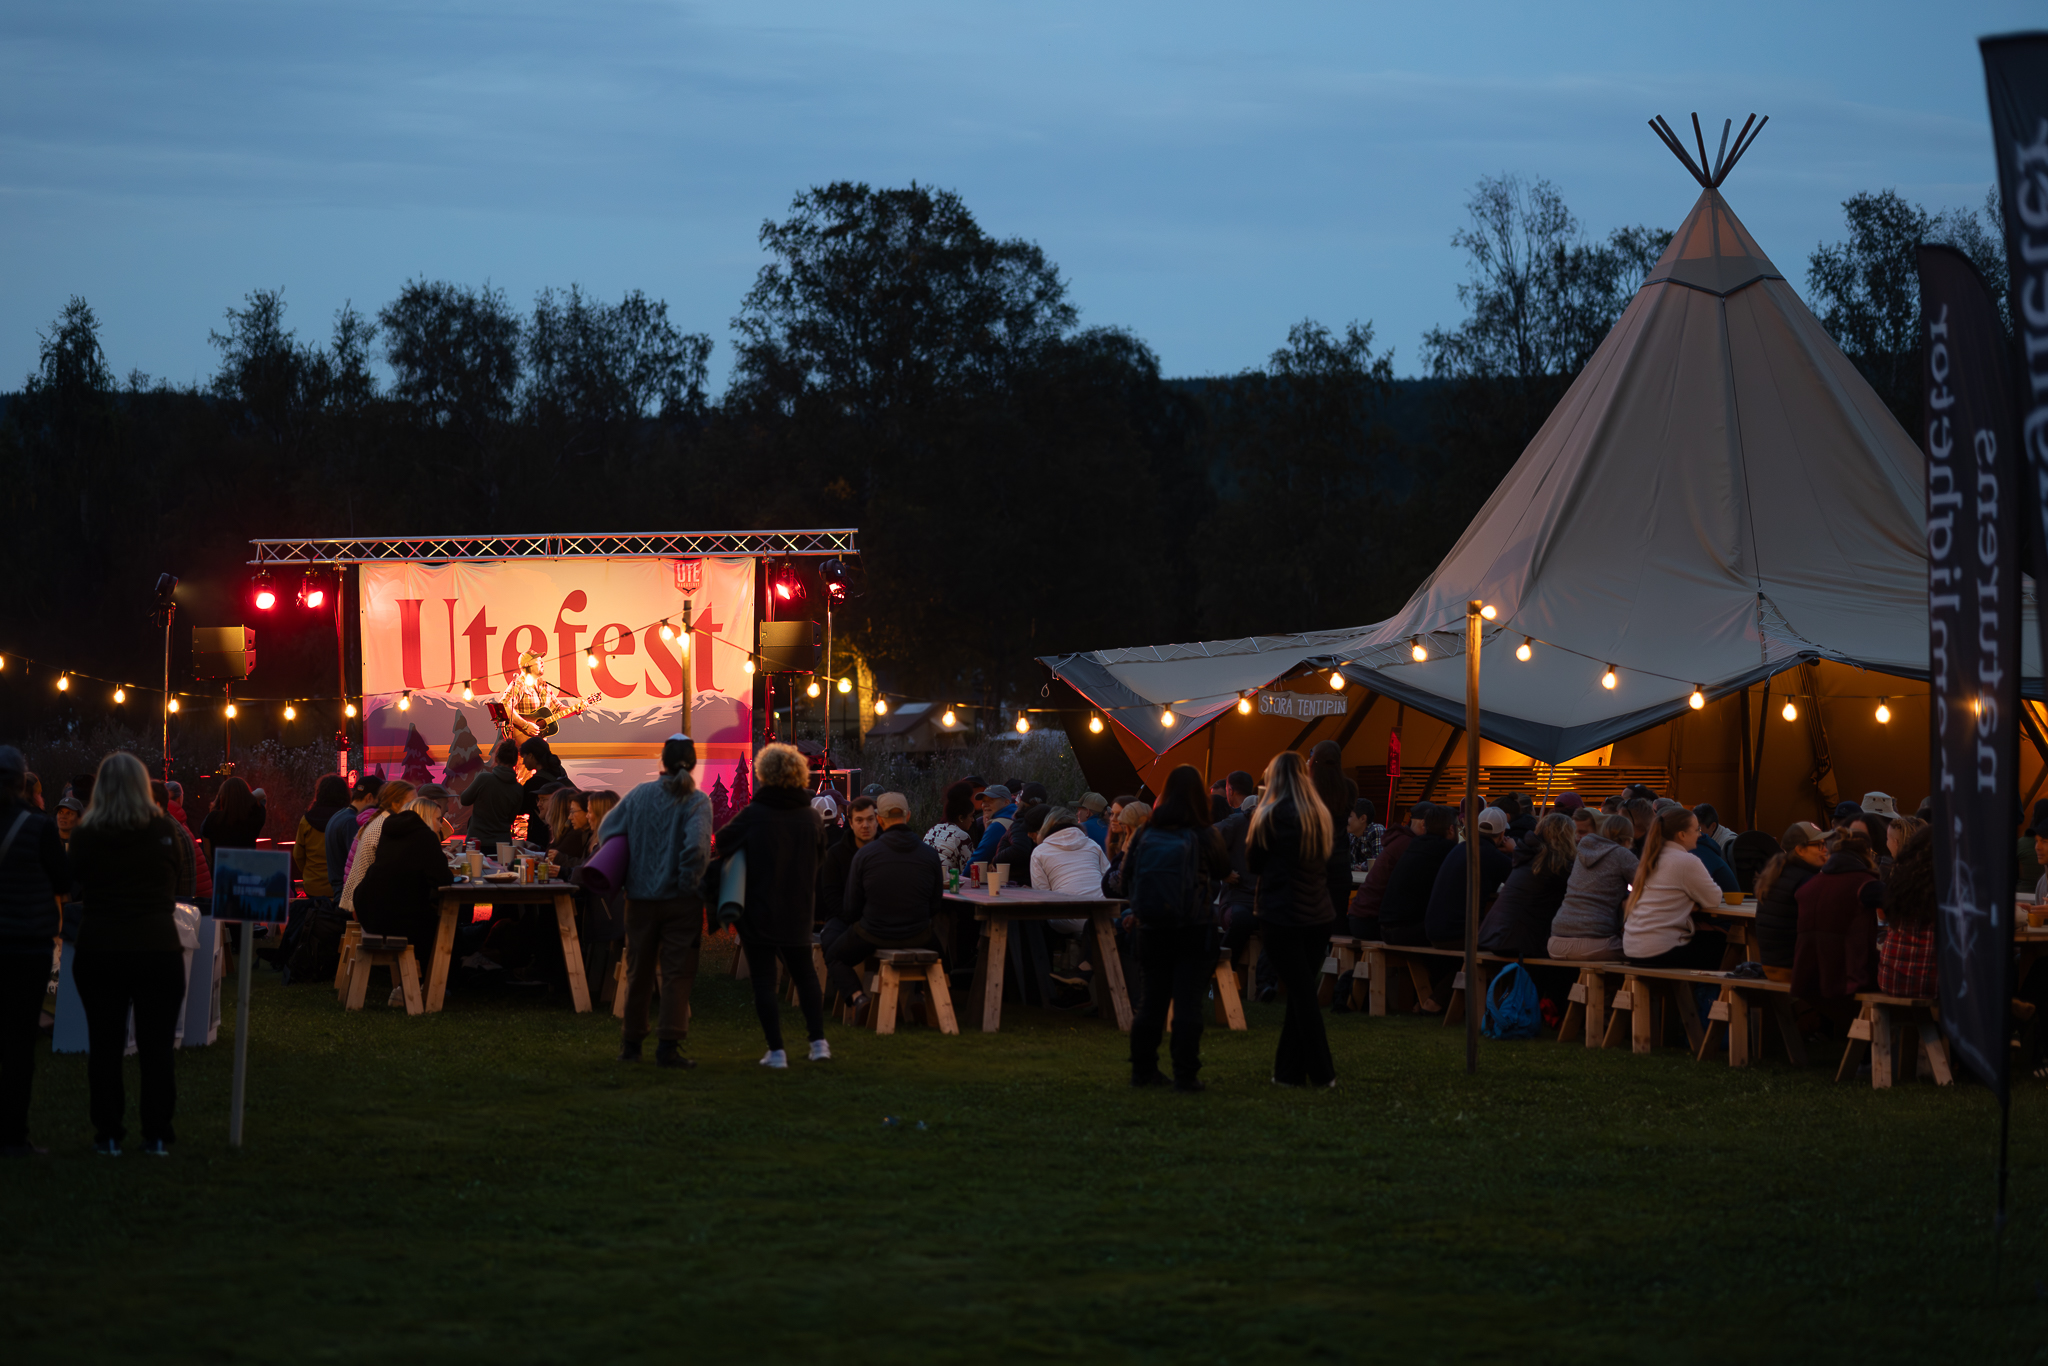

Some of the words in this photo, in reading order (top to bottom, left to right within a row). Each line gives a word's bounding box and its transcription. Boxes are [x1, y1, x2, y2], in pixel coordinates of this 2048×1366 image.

[677, 562, 700, 583] UTE
[395, 589, 725, 699] Utefest
[1260, 695, 1292, 715] STORA
[1297, 698, 1346, 716] TENTIPIN
